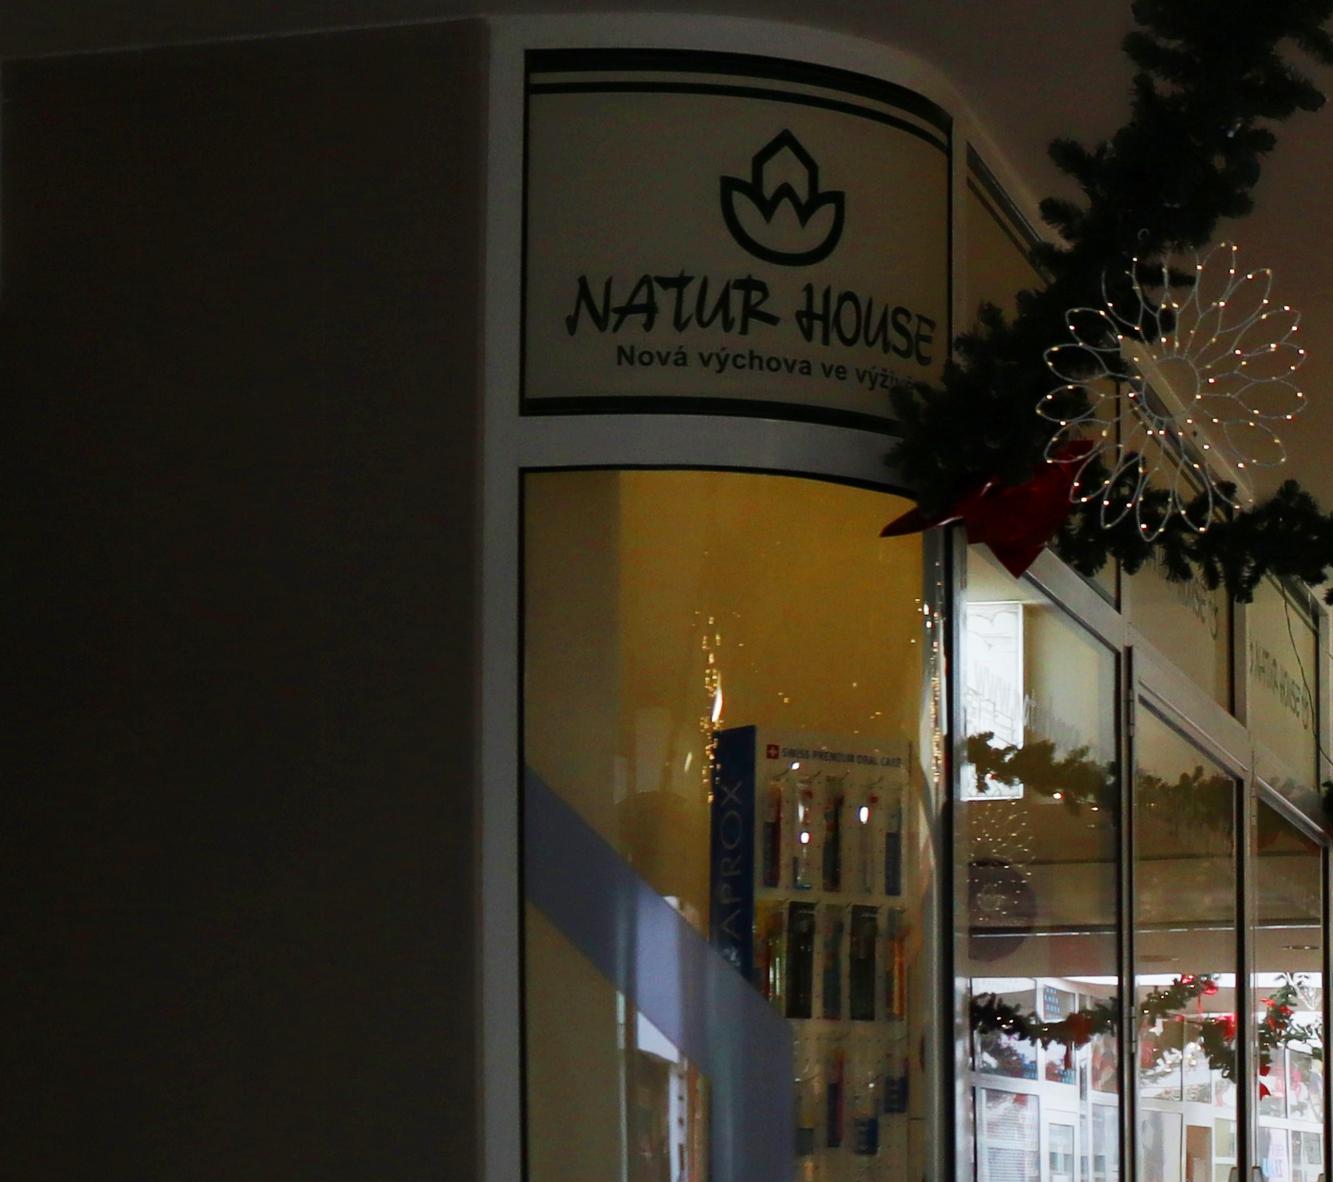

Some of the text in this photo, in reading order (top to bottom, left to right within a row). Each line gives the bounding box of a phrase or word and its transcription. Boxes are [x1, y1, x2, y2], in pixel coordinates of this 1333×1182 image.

[565, 269, 936, 366] NATUR HOUSE
[616, 344, 689, 368] Nová
[699, 347, 812, 377] výchova
[821, 363, 848, 381] ve
